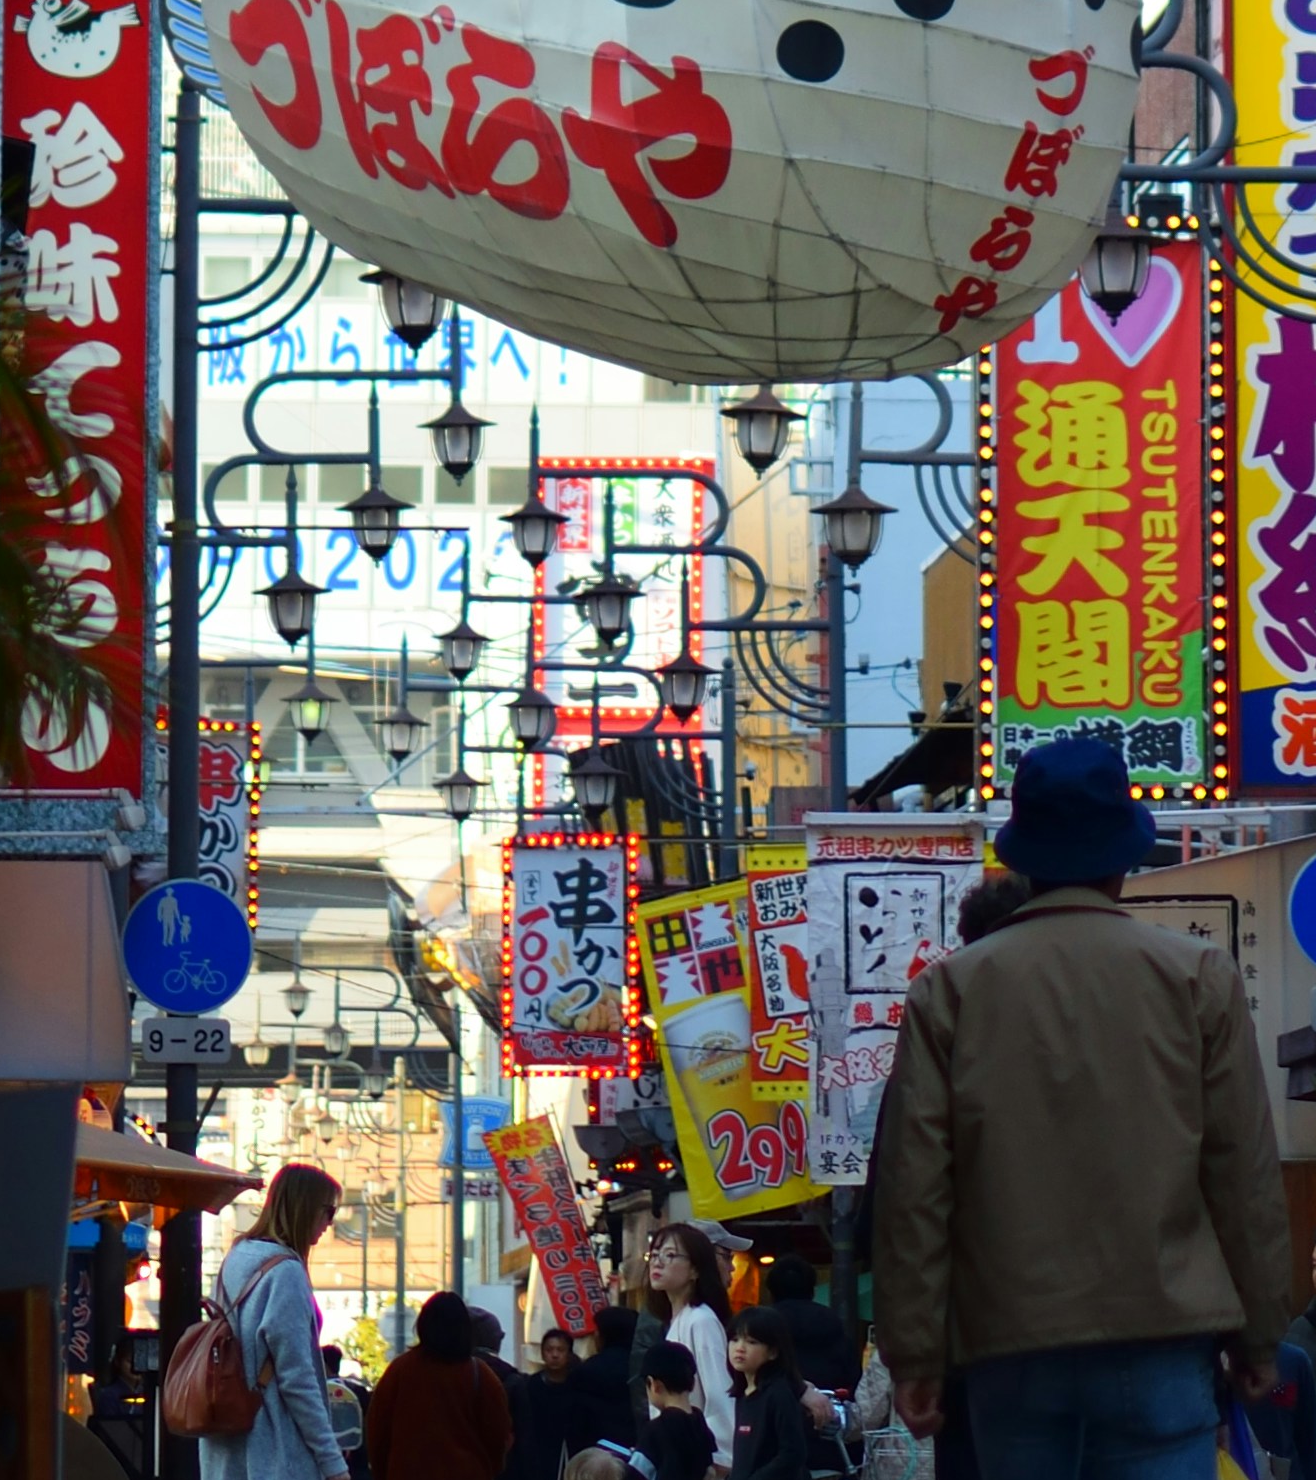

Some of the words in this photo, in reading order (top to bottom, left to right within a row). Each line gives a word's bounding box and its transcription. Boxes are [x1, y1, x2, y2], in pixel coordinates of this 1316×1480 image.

[933, 41, 1096, 334] づぼらや
[1013, 378, 1131, 708] 通天閣
[1140, 378, 1181, 706] TSUTENKAKU
[548, 857, 620, 1015] 串かつ
[816, 834, 975, 859] 元祖串カツ専門店
[707, 1101, 807, 1189] 299
